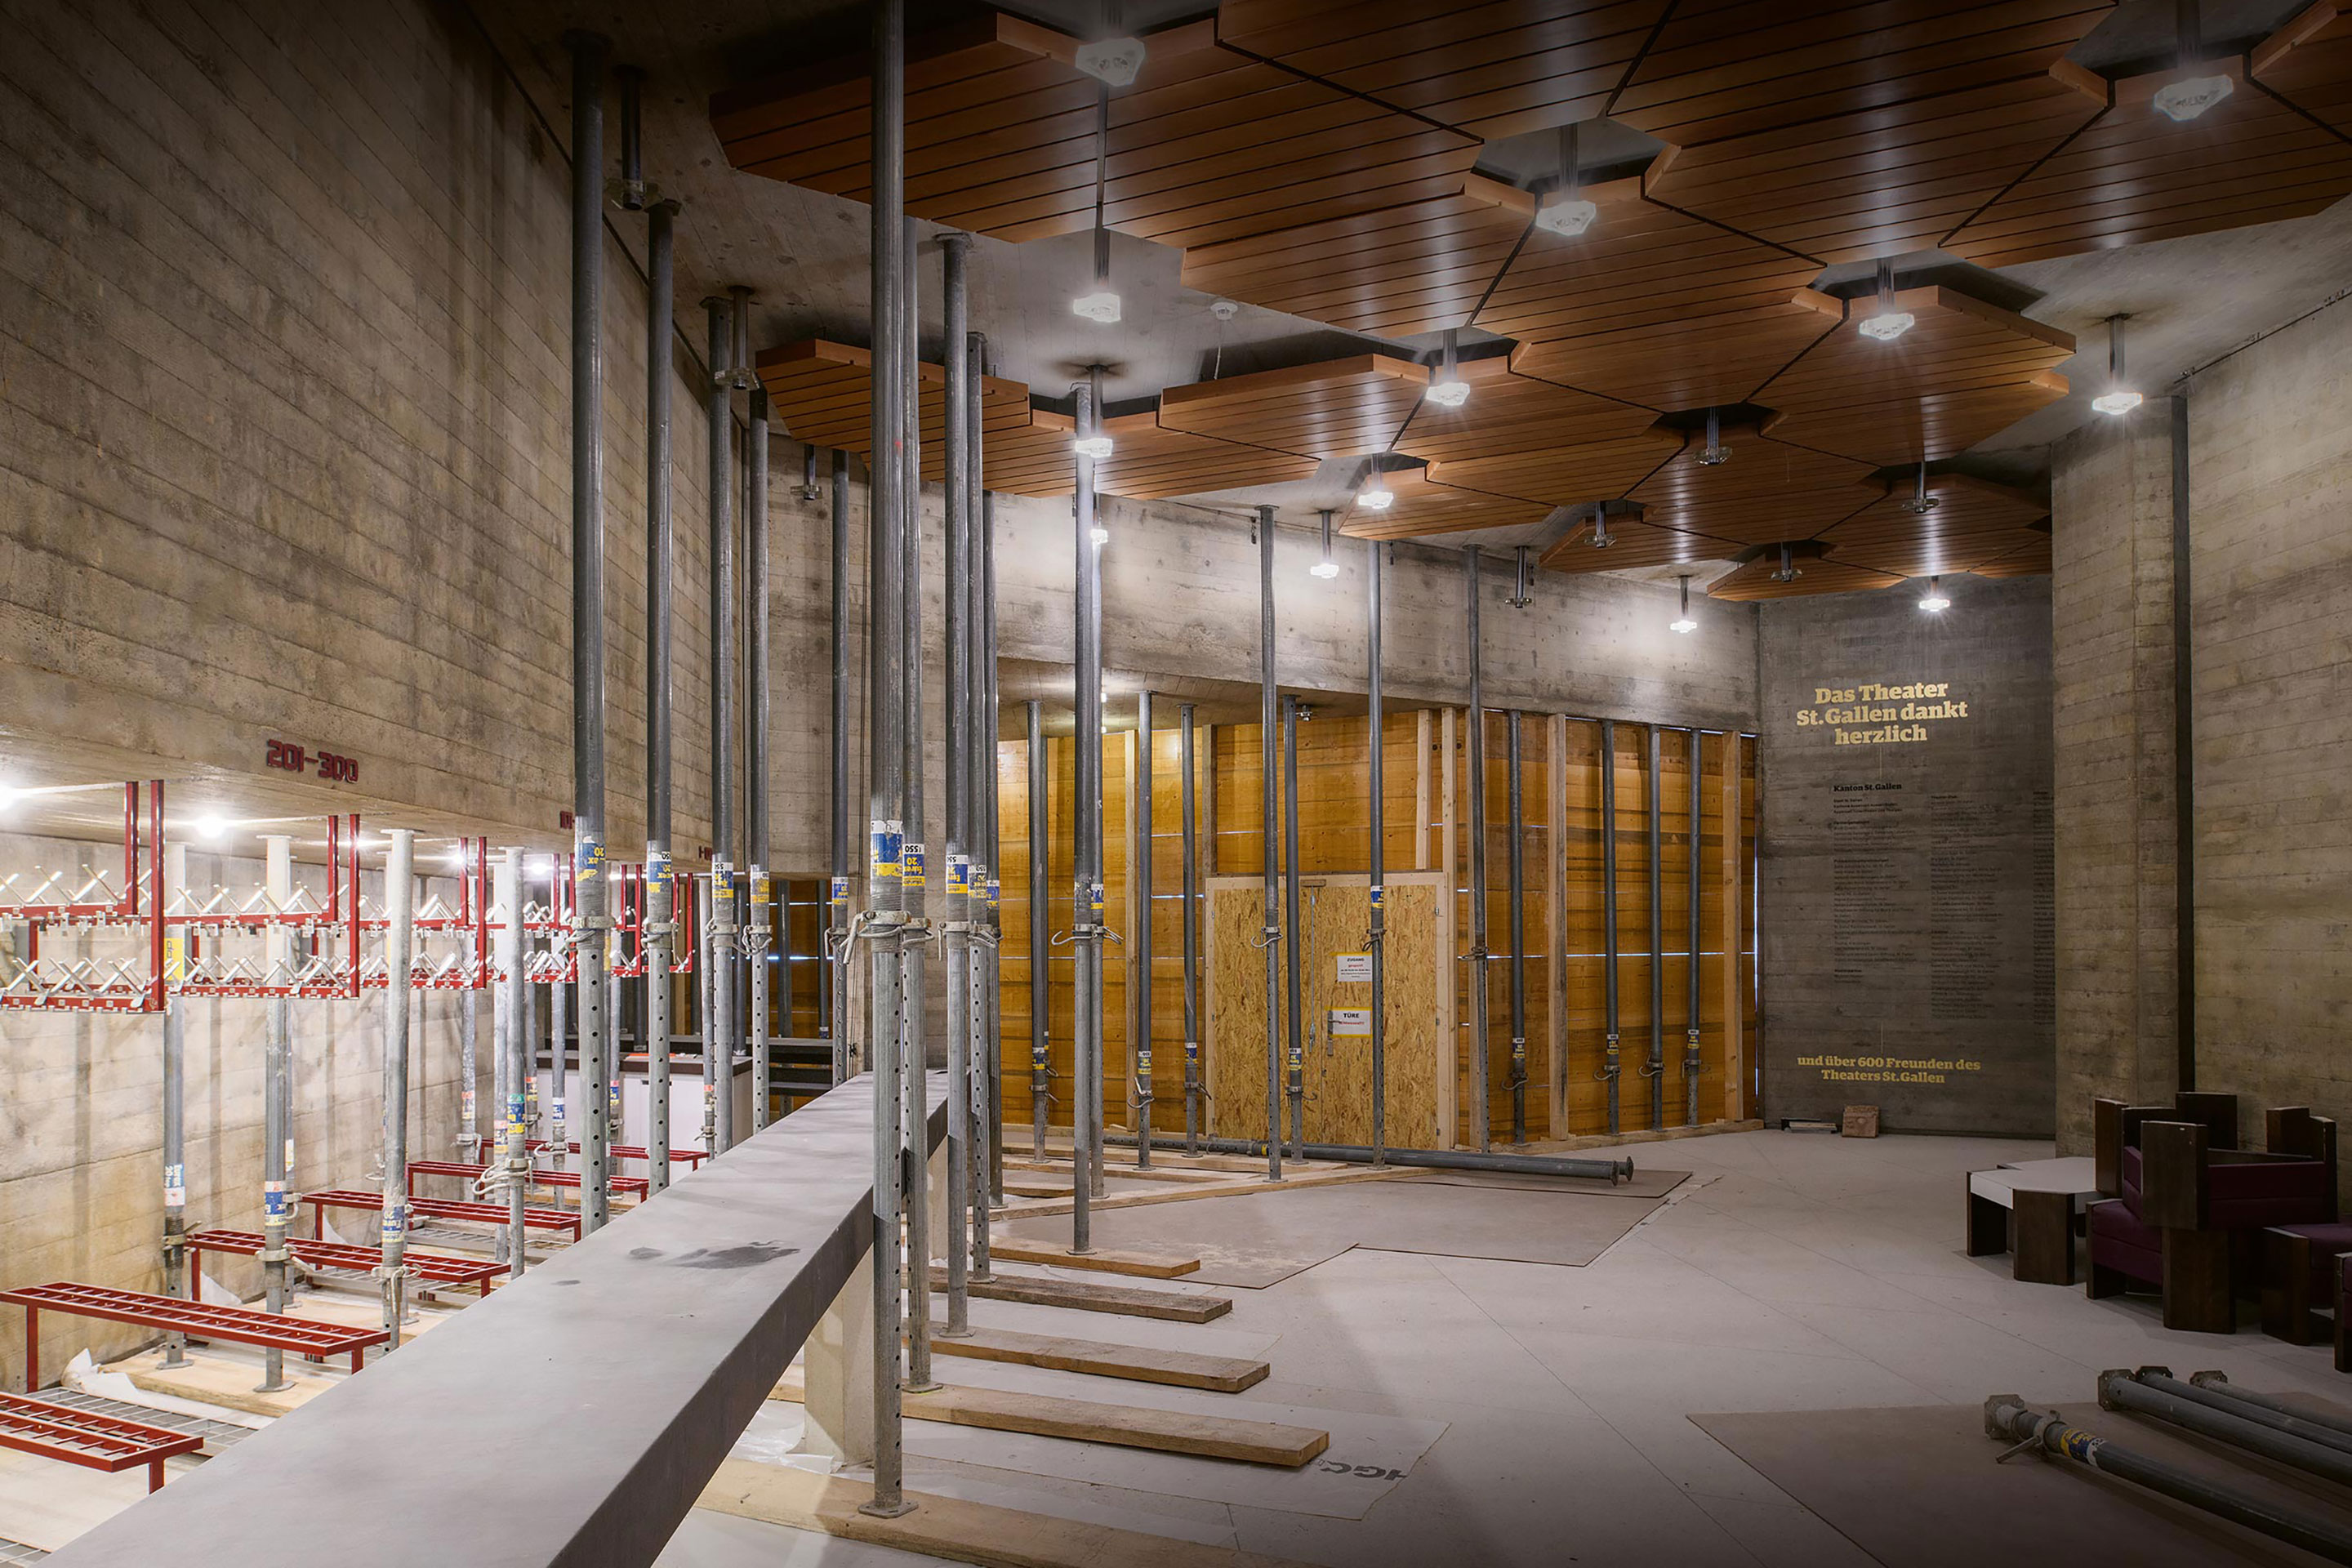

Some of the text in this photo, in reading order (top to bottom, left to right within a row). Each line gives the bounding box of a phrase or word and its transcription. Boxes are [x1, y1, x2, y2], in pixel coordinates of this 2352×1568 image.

[1815, 682, 1949, 704] Das Theater
[1900, 700, 1969, 721] dankt
[1834, 724, 1928, 745] herzlich
[267, 738, 359, 784] 201-300
[1833, 784, 1864, 792] Kanton
[906, 857, 918, 866] 20
[1797, 1055, 1981, 1071] und über 600 Freunden des
[1821, 1069, 1881, 1082] Theaters
